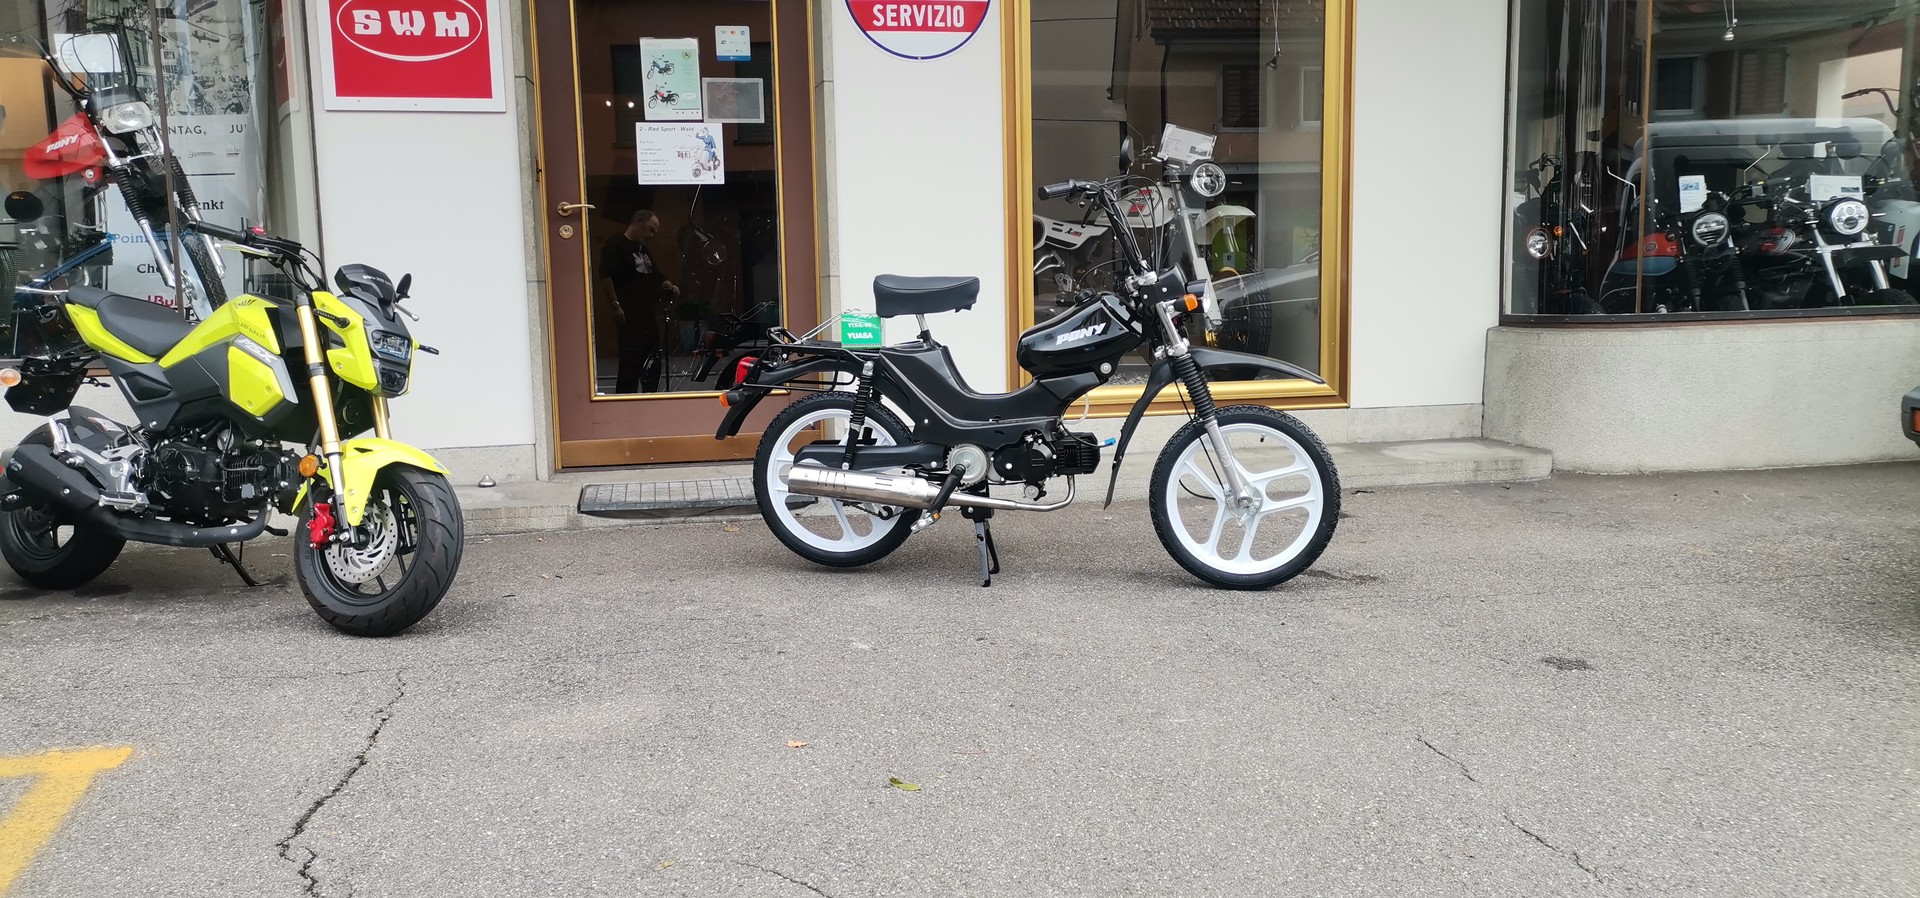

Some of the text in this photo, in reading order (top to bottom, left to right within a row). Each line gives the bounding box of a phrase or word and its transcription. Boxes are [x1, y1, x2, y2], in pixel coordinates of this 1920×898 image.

[351, 9, 470, 38] SWM
[872, 4, 965, 28] SERVIZIO
[45, 134, 79, 154] PONY
[846, 332, 874, 340] YUASA
[1055, 322, 1107, 346] PONY
